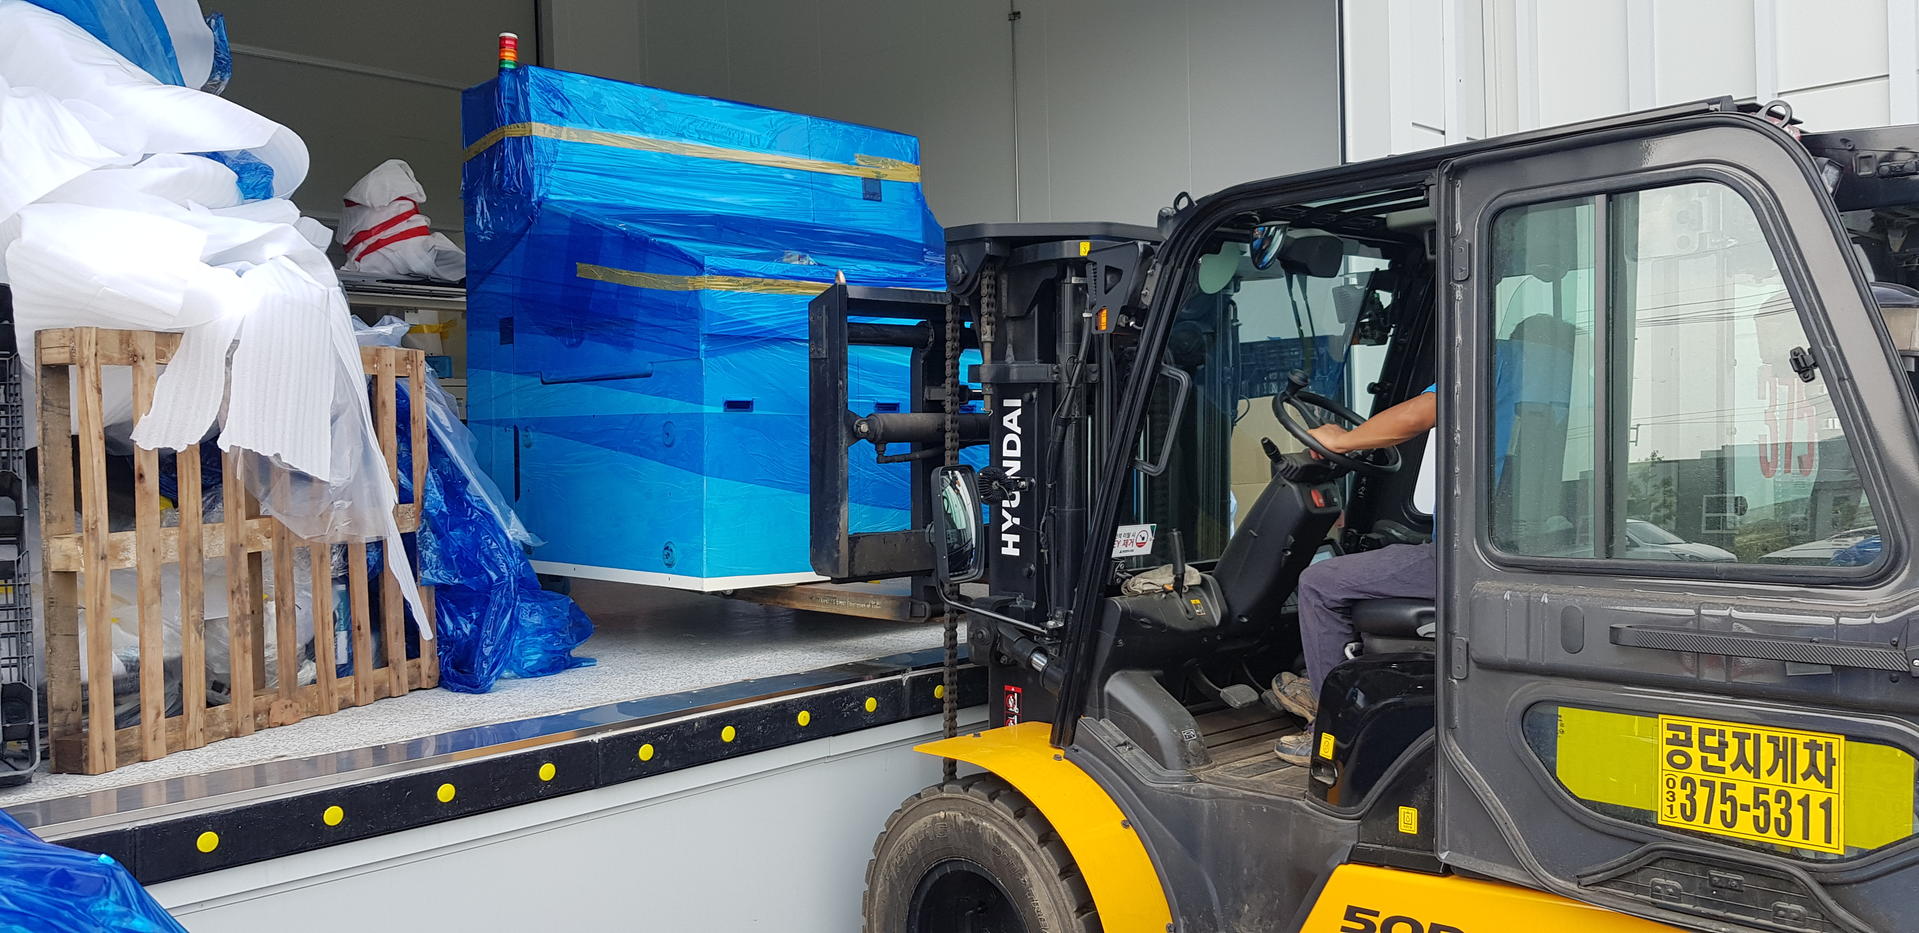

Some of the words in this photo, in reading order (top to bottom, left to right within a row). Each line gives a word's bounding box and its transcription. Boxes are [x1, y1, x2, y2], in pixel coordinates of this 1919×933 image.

[1001, 398, 1022, 557] HYUNDAI
[1664, 722, 1836, 790] 공단지게차
[1679, 776, 1833, 845] 375-5311
